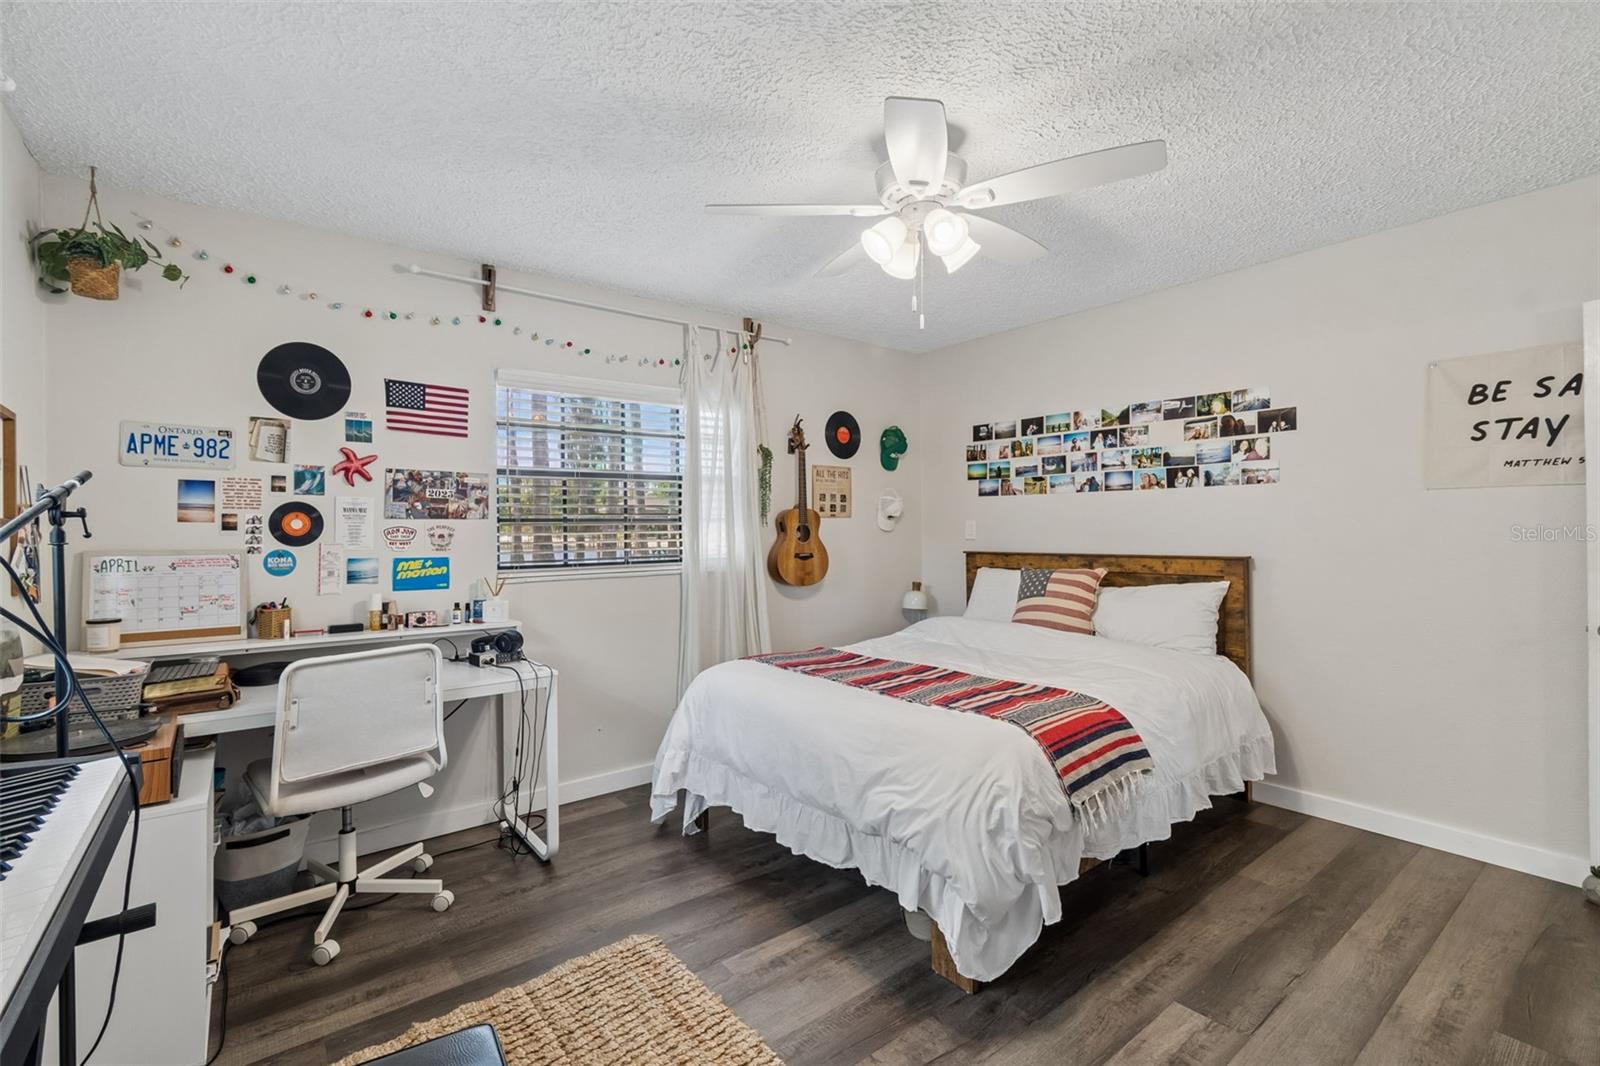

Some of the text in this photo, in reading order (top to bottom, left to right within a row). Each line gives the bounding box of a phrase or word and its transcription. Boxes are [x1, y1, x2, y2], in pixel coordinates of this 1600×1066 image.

[1467, 373, 1584, 405] BE SA
[1470, 414, 1570, 447] STAY
[126, 432, 230, 460] APME 982
[1503, 457, 1573, 468] MATTHEW
[816, 469, 825, 478] ALL
[386, 528, 414, 536] RON JON
[100, 558, 141, 573] APRIL
[267, 556, 293, 564] KONA
